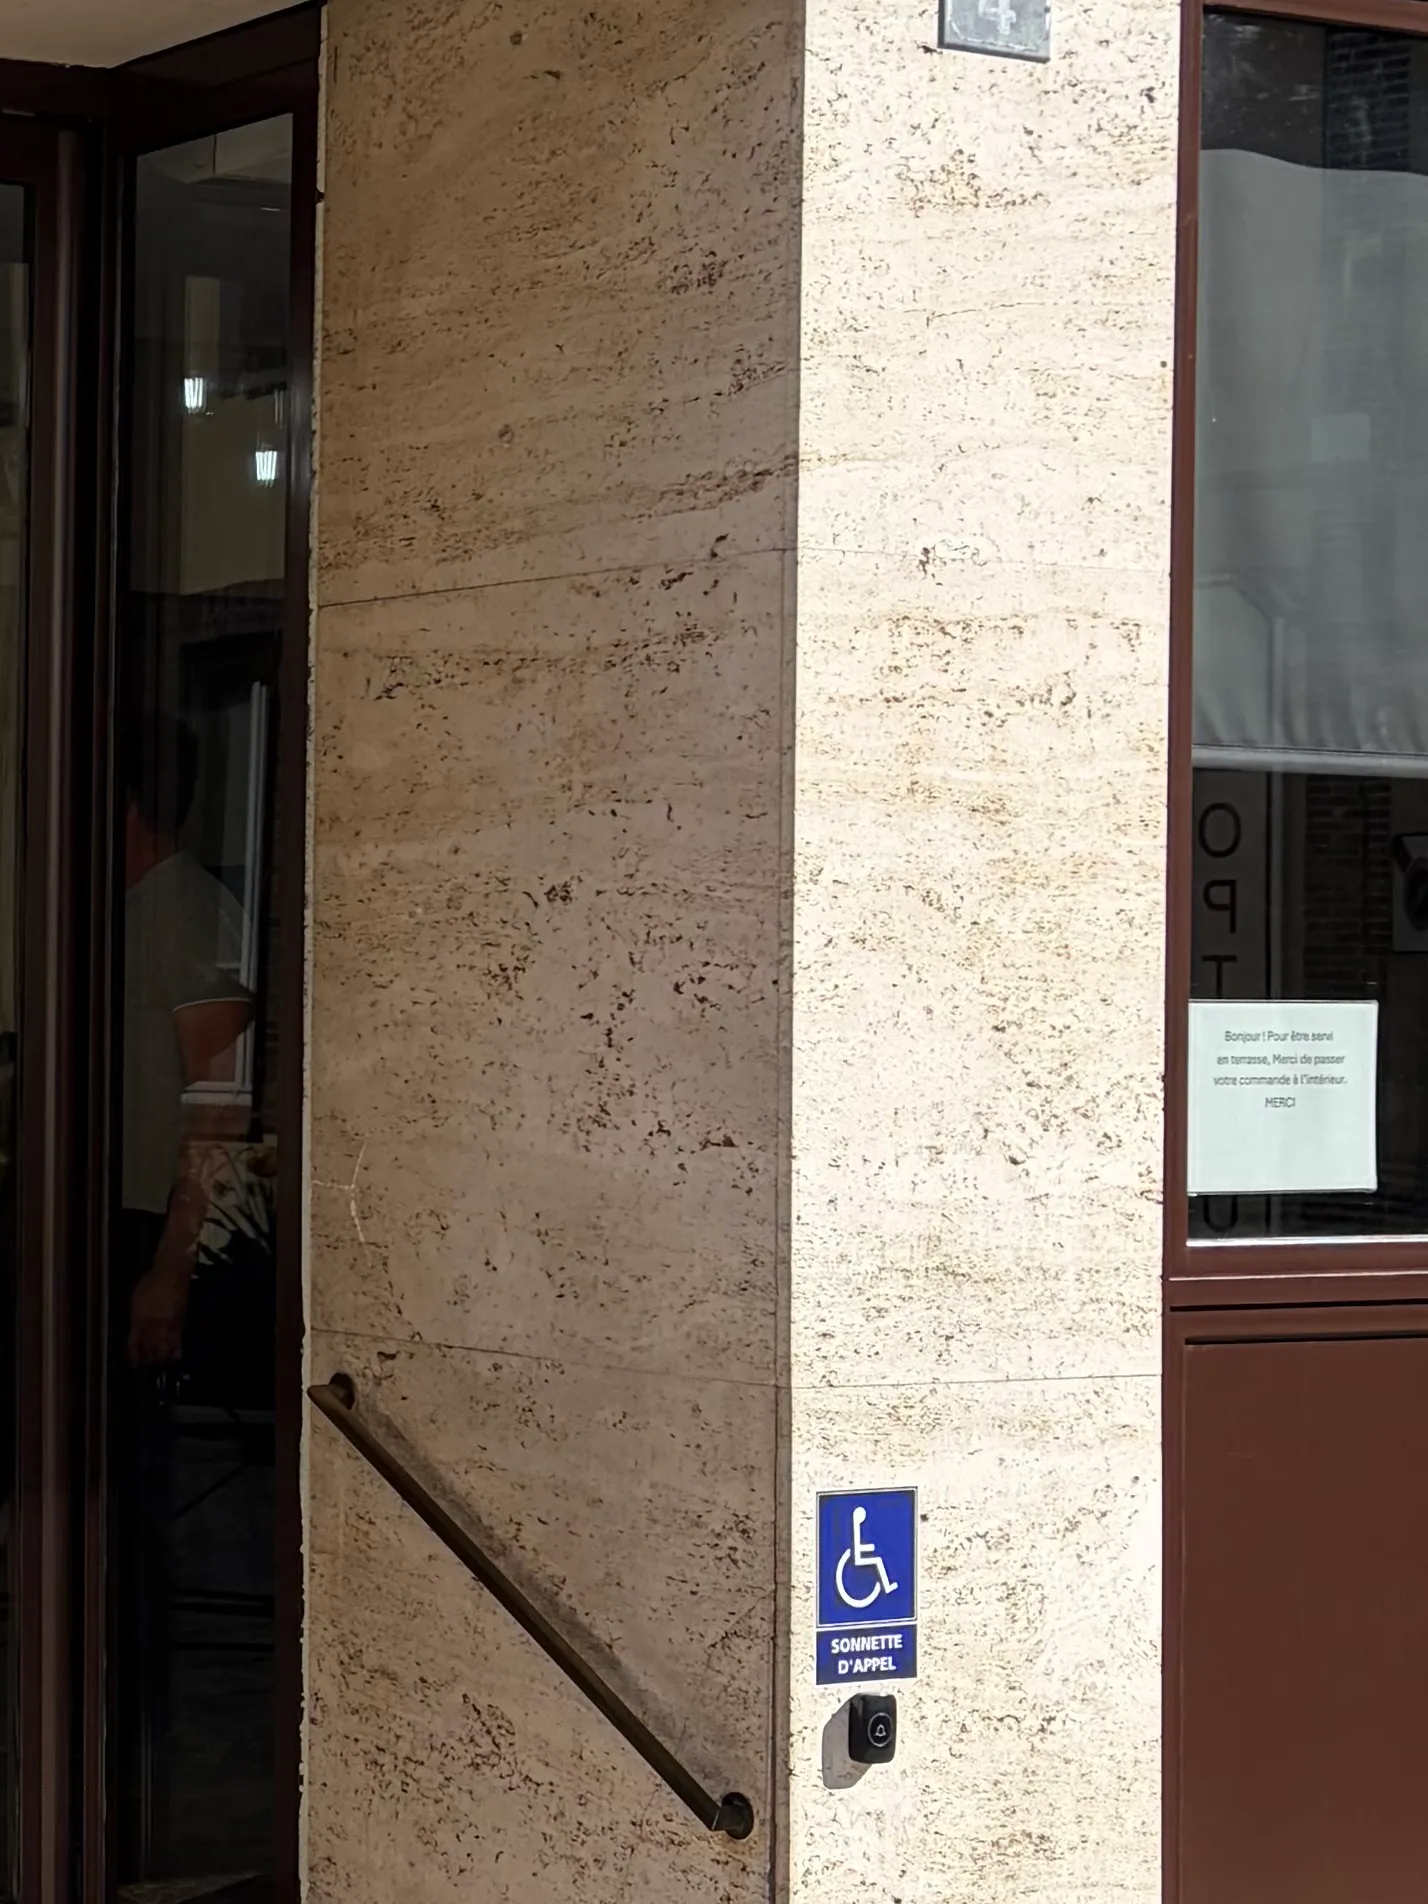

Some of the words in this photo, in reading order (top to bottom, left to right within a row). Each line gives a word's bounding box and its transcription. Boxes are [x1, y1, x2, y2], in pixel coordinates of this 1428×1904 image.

[1223, 1030, 1261, 1043] Bonjour
[1267, 1031, 1289, 1041] Pour
[1291, 1030, 1309, 1041] être
[1311, 1031, 1333, 1041] servi
[1217, 1056, 1228, 1065] en
[1231, 1055, 1271, 1066] terrasse,
[1272, 1054, 1298, 1065] Merci
[1300, 1054, 1312, 1065] de
[1314, 1056, 1345, 1066] passer
[1213, 1076, 1237, 1086] votre
[1239, 1075, 1291, 1086] commande
[1264, 1097, 1296, 1108] MERCI
[830, 1634, 903, 1654] SONNETTE
[837, 1656, 897, 1675] D'APPEL
